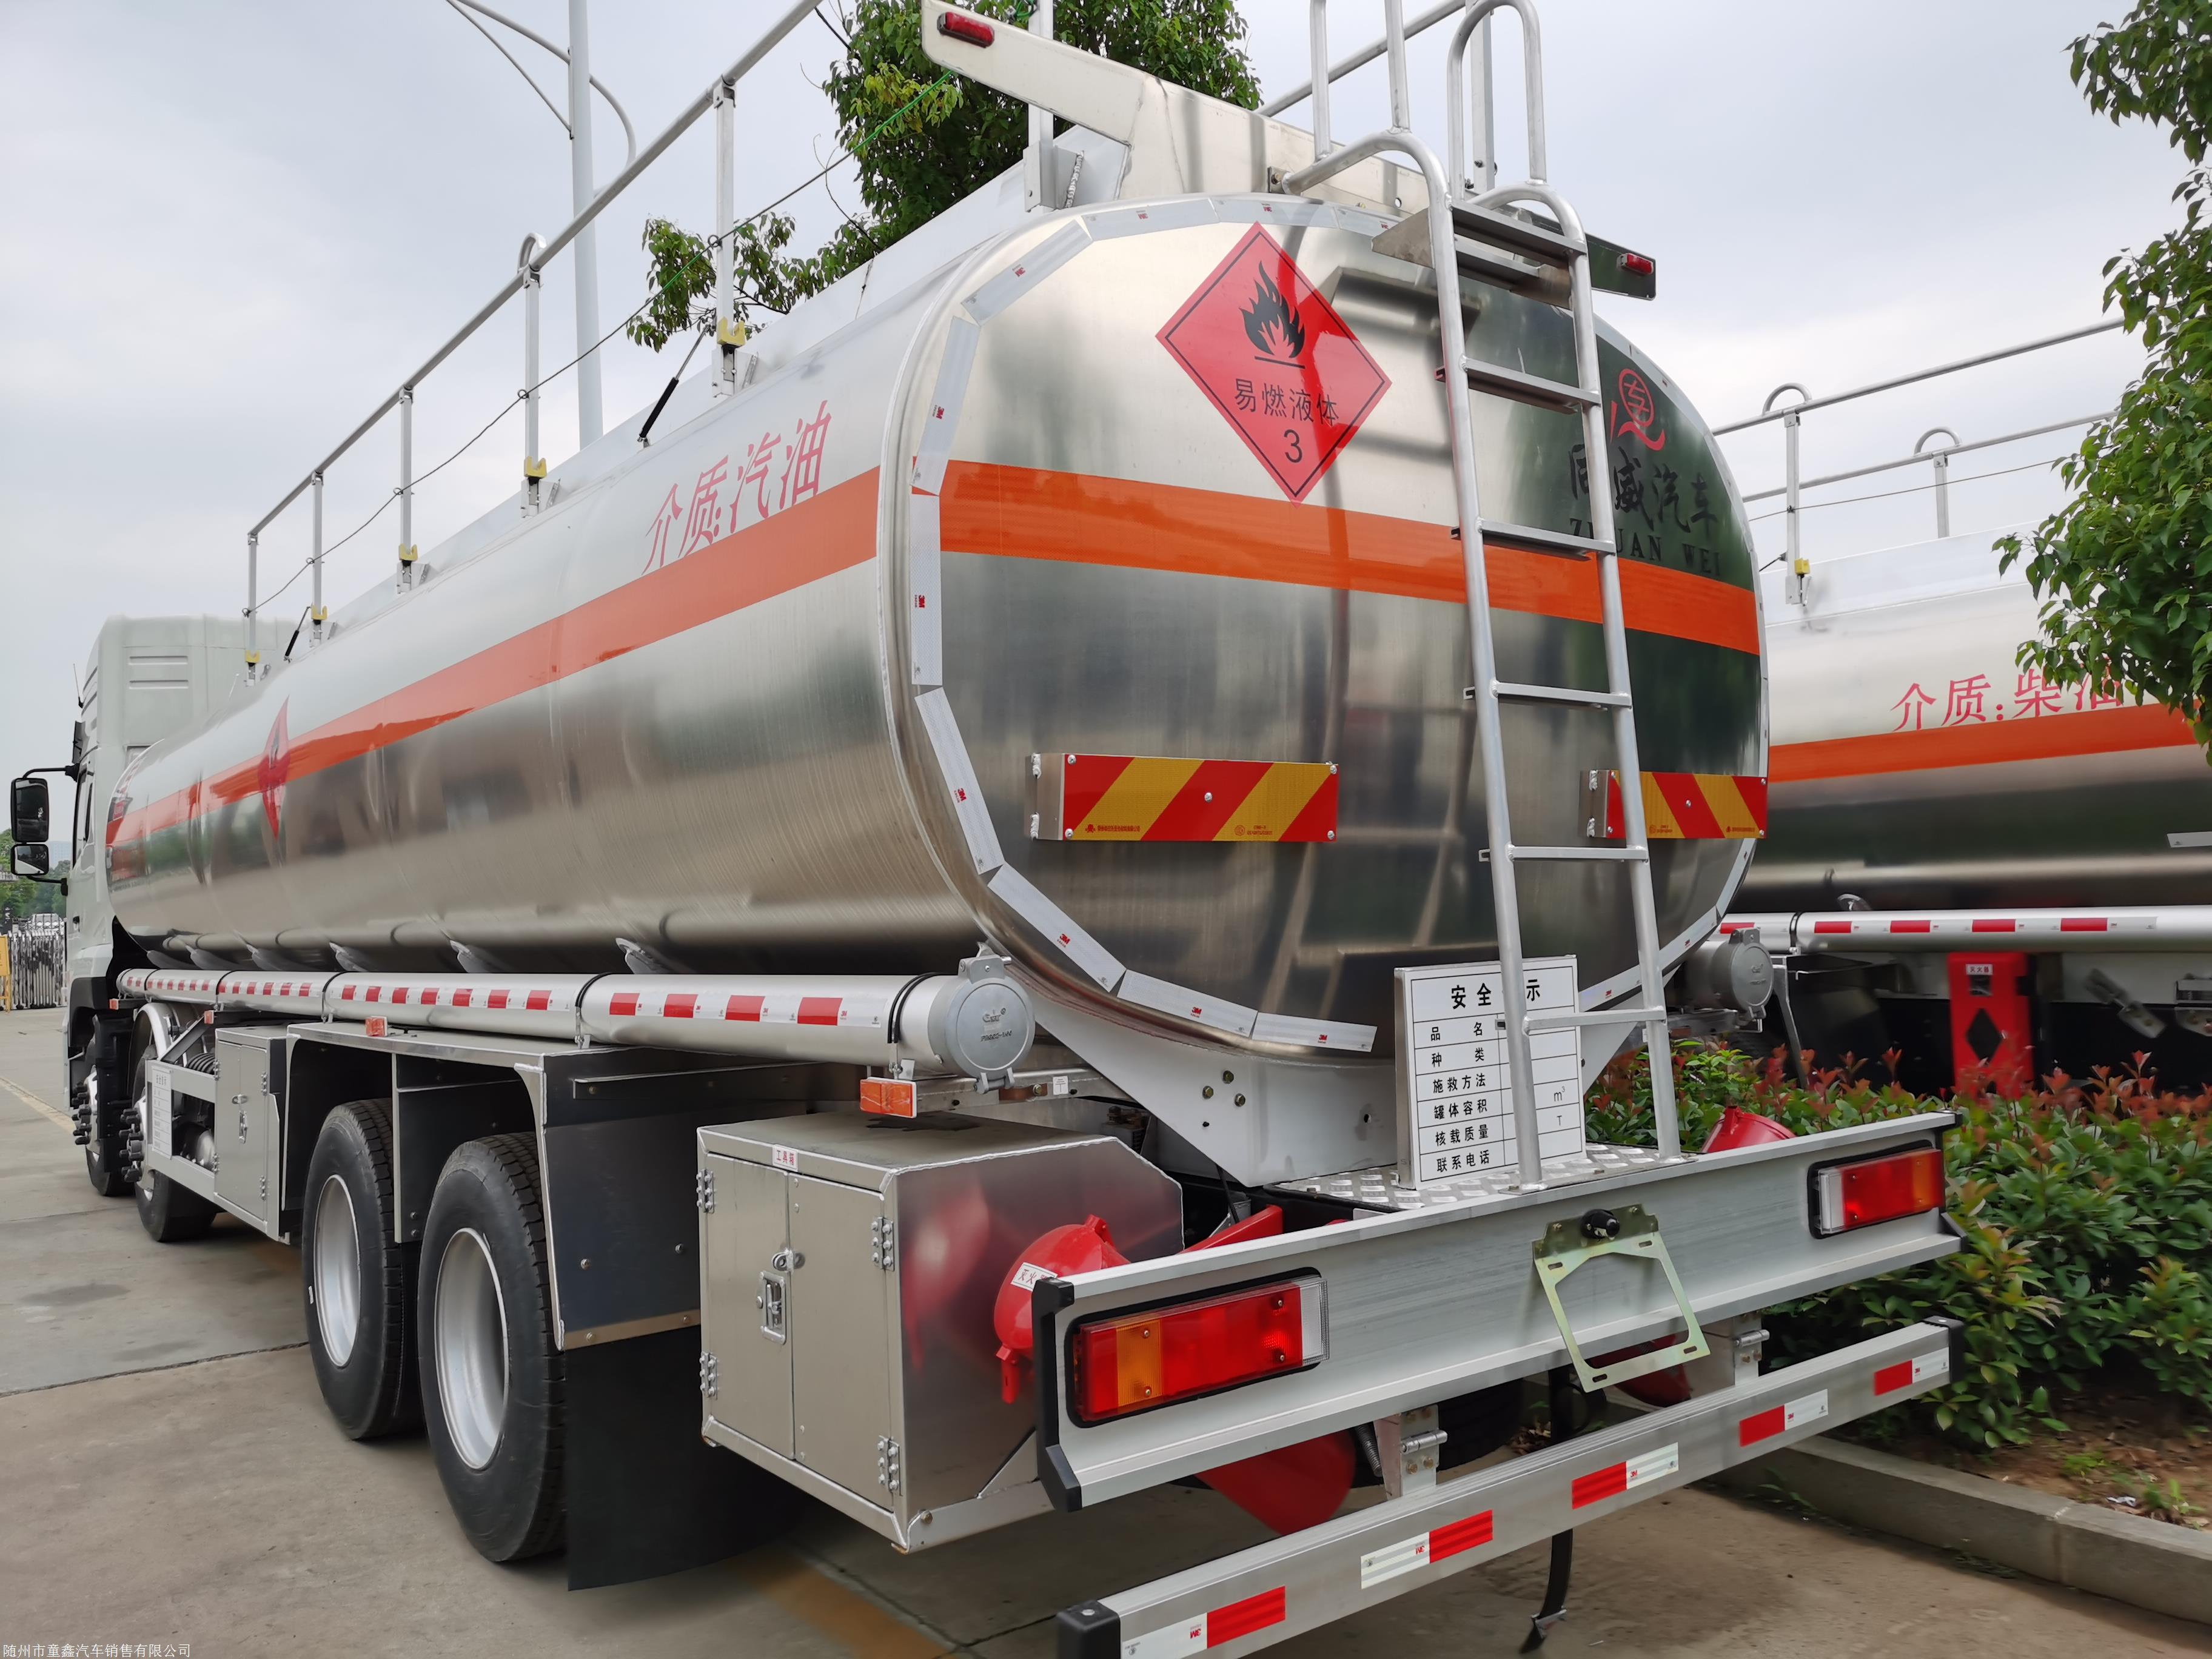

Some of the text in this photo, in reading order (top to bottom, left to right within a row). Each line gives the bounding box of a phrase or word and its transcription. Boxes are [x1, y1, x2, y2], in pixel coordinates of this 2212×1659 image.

[1235, 378, 1339, 426] 易燃液体
[1283, 429, 1303, 463] 3
[918, 594, 925, 608] 3M
[957, 788, 967, 802] 3M
[1059, 933, 1070, 945] 3M
[1451, 979, 1541, 1010] 安全示
[1191, 1007, 1202, 1015] 3M
[1430, 1021, 1483, 1042] 品名
[1431, 1047, 1485, 1068] 种类
[1433, 1073, 1486, 1094] 施救方法
[1434, 1098, 1488, 1121] 罐体容积
[1557, 1115, 1563, 1127] T
[1435, 1124, 1489, 1147] 核载质量
[777, 1149, 795, 1166] 工具箱
[1436, 1149, 1490, 1173] 联系电话
[1415, 1545, 1426, 1555] 3M
[1190, 1628, 1202, 1639] 3M
